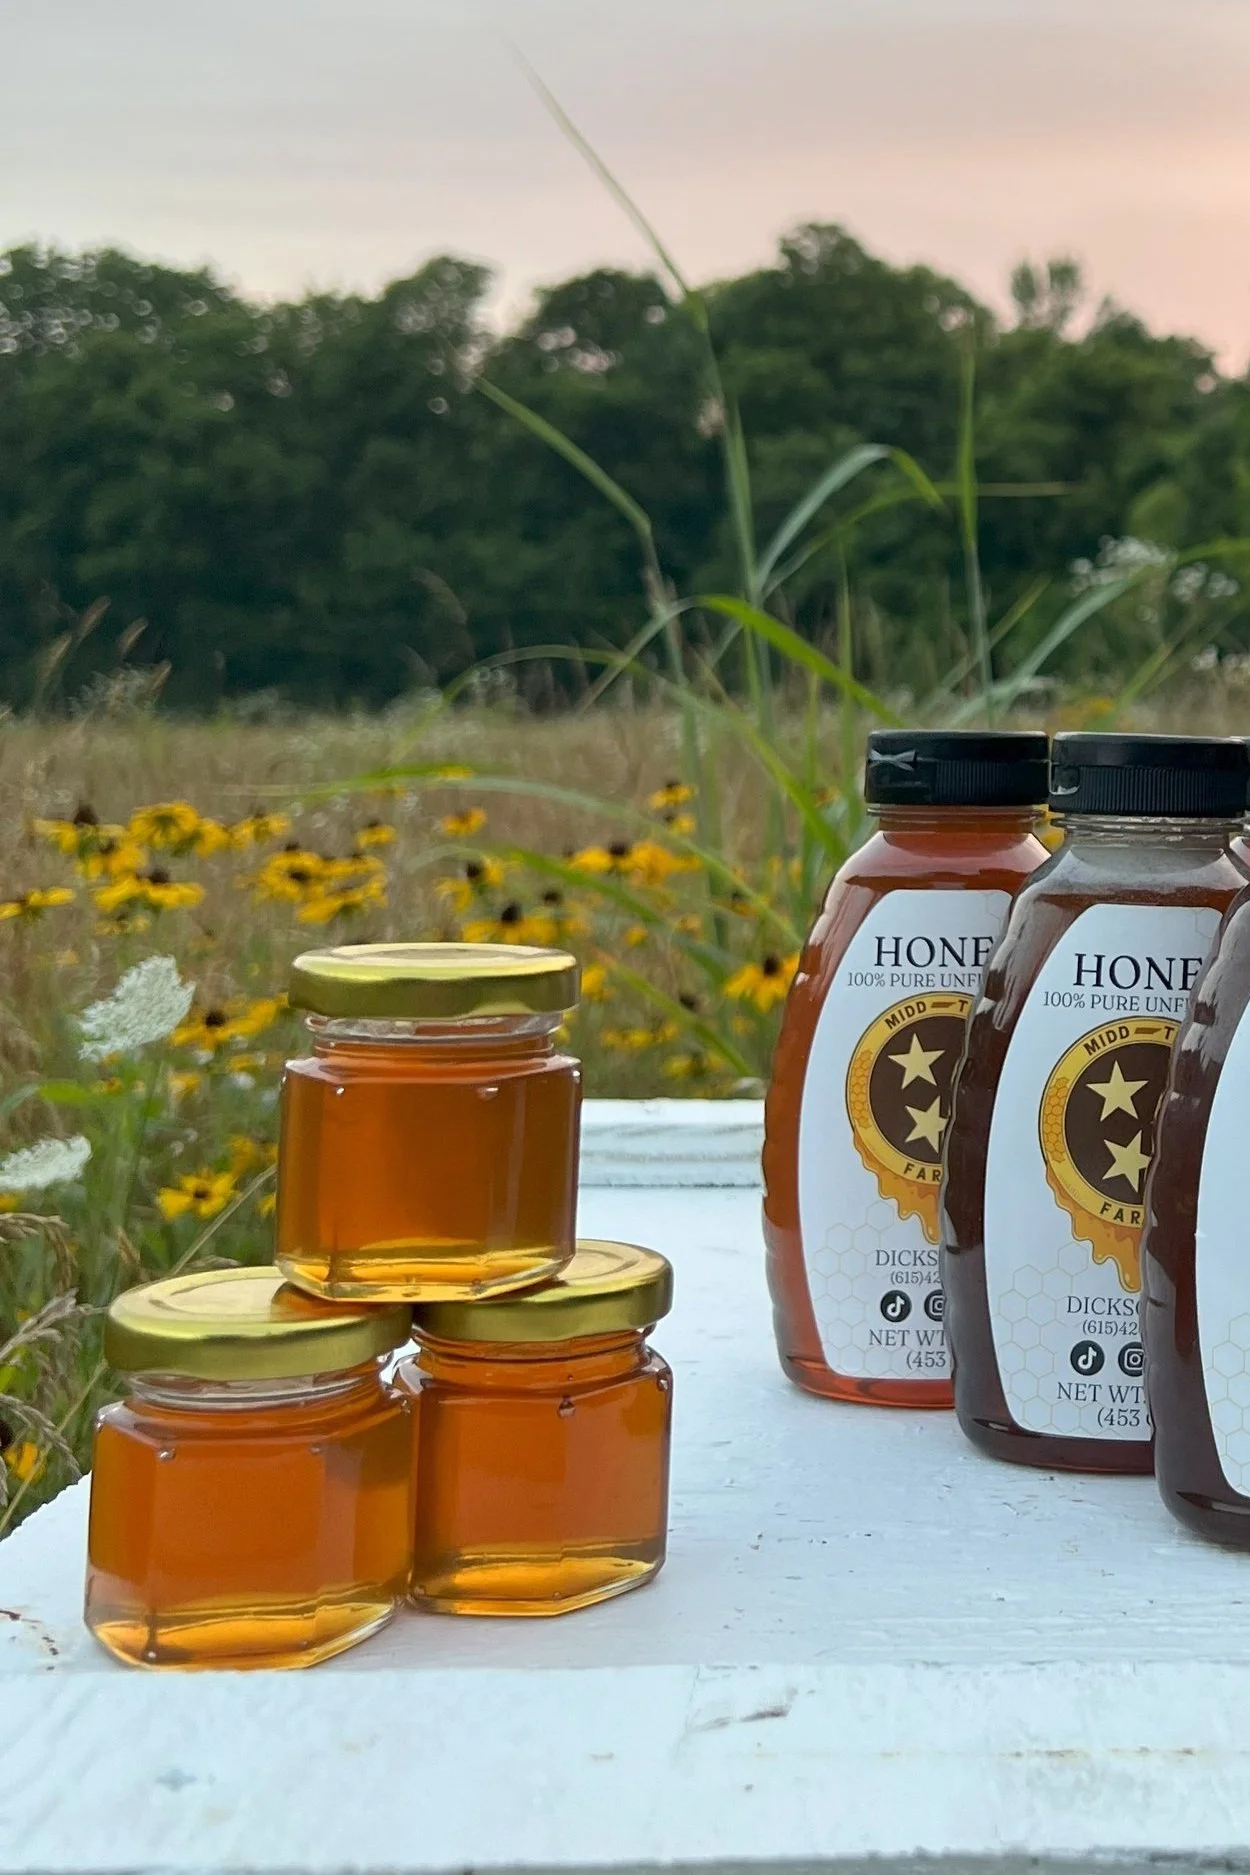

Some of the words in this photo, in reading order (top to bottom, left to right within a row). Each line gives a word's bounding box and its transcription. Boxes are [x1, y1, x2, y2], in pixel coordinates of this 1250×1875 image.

[874, 936, 994, 968] HONE
[847, 972, 886, 987] 100%
[890, 973, 936, 988] PURE
[1072, 953, 1203, 991] HONE
[1043, 991, 1086, 1009] 100%
[1091, 994, 1140, 1012] PURE
[884, 1000, 927, 1030] MIDD
[1083, 1026, 1130, 1056] MIDD
[903, 1163, 941, 1182] FAR
[1100, 1202, 1142, 1225] FAR
[876, 1250, 938, 1267] DICKS
[890, 1271, 941, 1285] (615)42
[1066, 1295, 1140, 1317] DICKS
[869, 1329, 910, 1346] NET
[916, 1330, 946, 1347] WT
[1082, 1319, 1138, 1337] (615)42
[906, 1351, 946, 1369] (453
[1057, 1381, 1102, 1402] NET
[1097, 1407, 1141, 1427] (453
